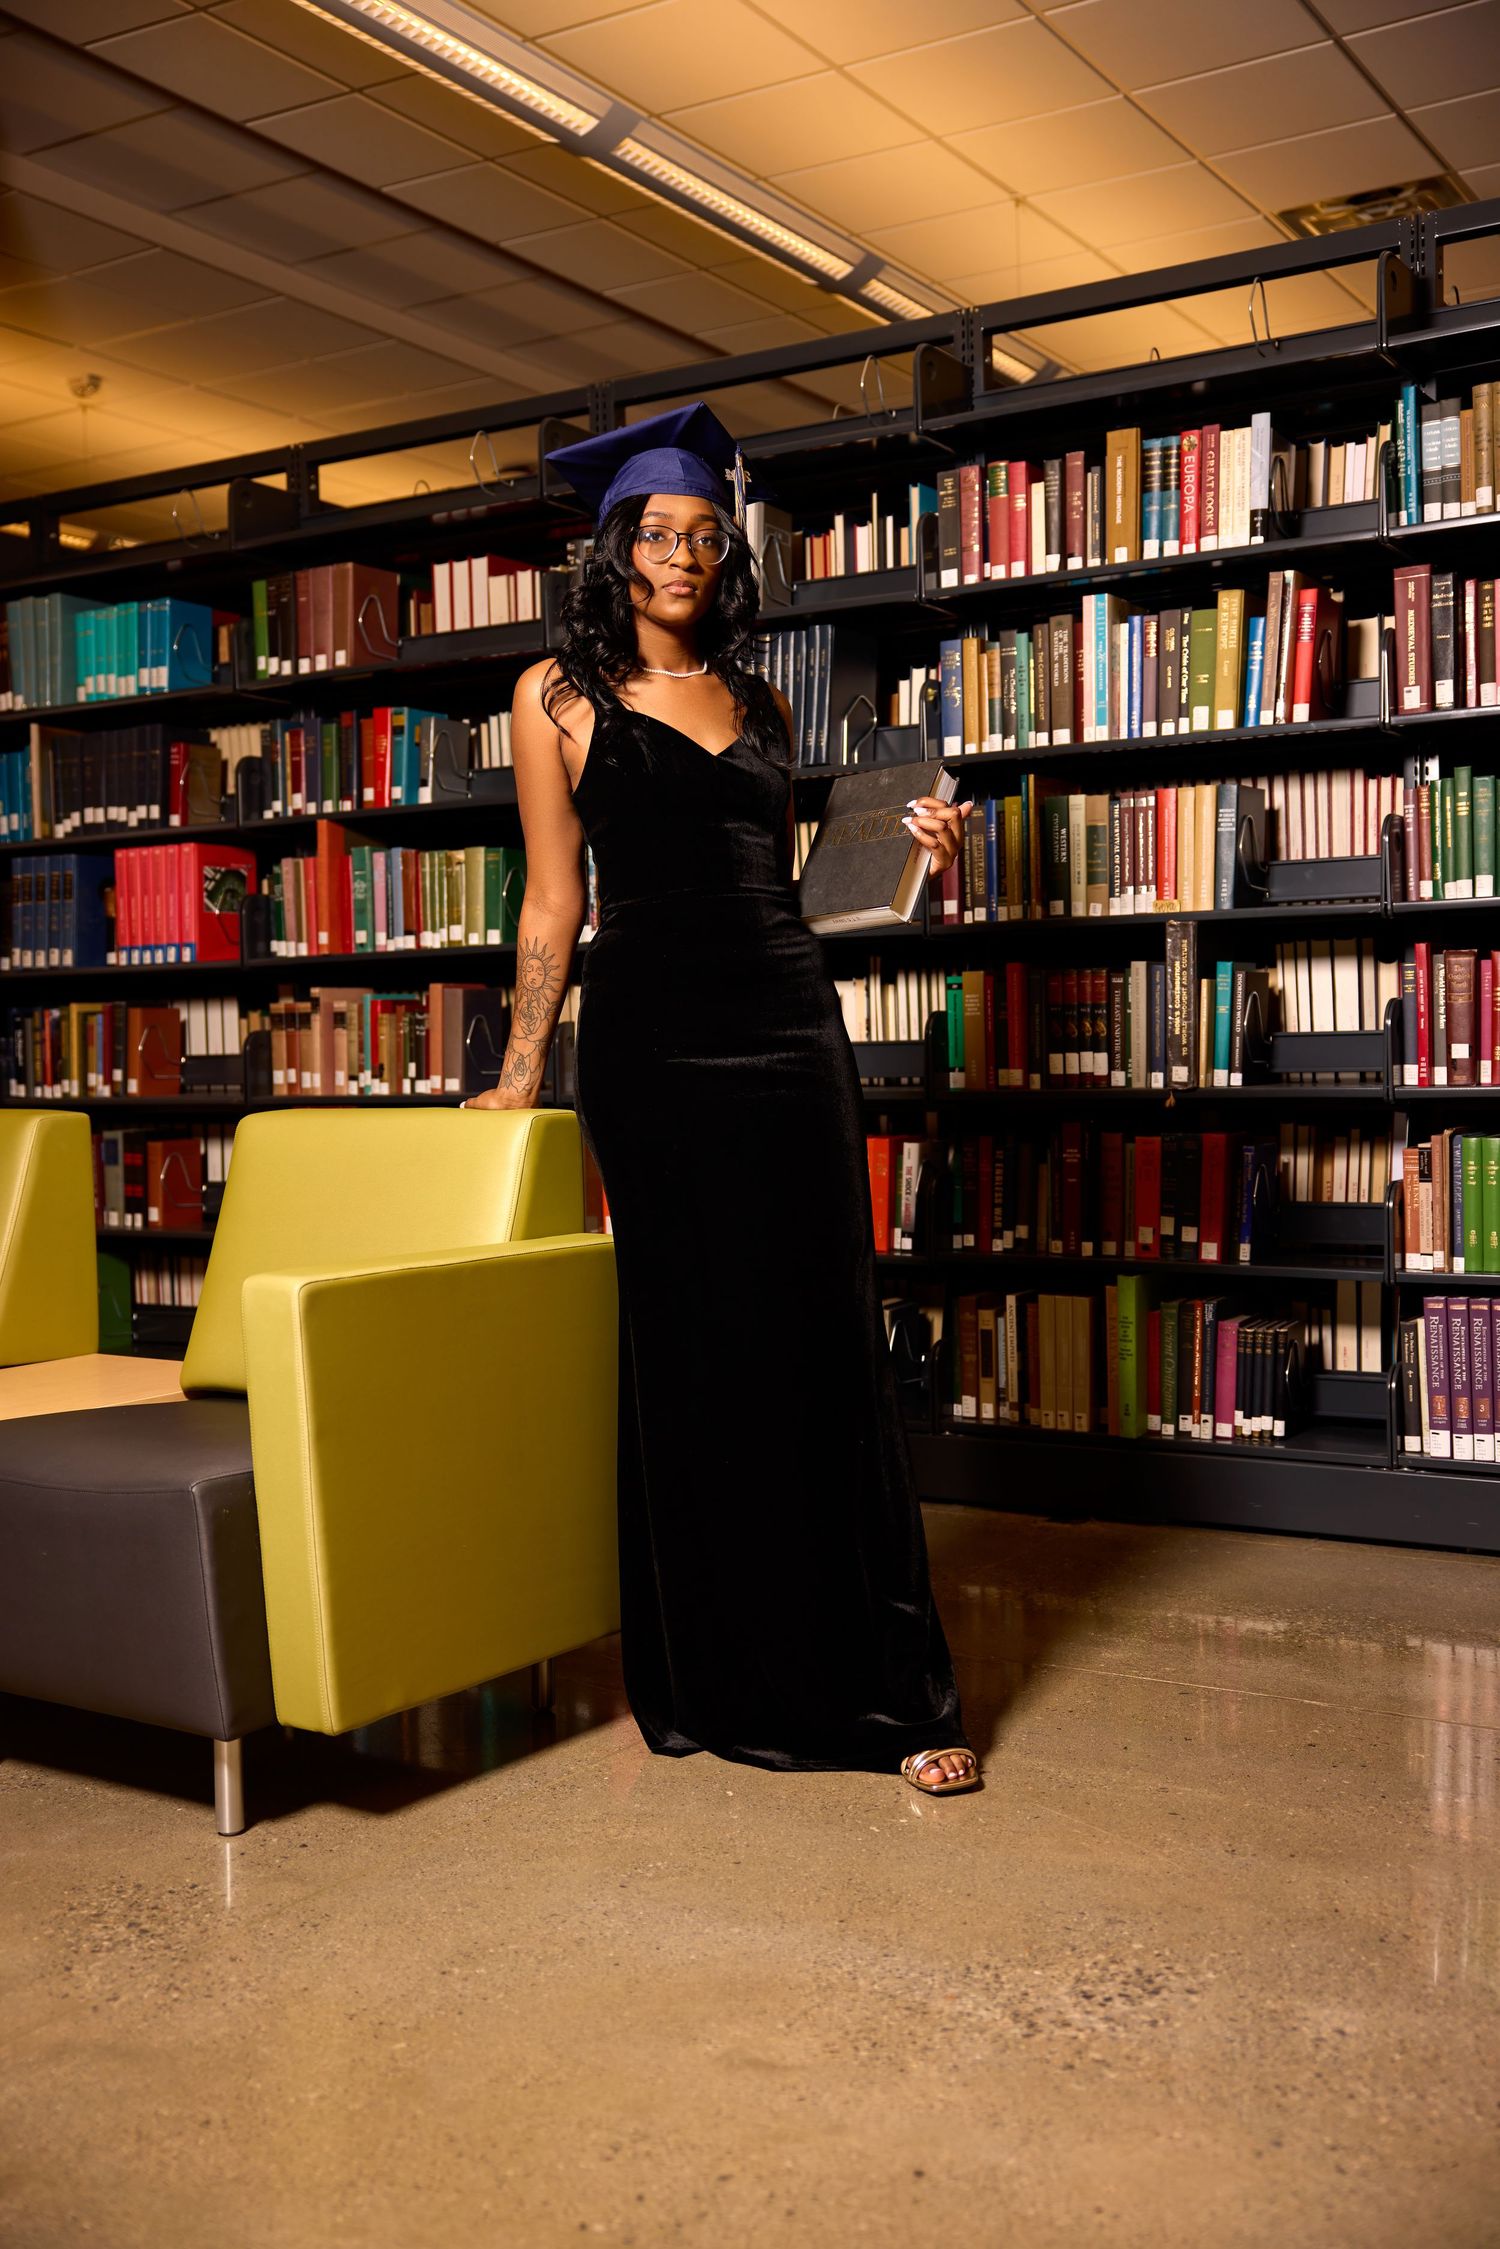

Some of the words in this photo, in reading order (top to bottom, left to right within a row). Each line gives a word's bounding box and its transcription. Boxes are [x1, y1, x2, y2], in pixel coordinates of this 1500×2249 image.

[1184, 455, 1195, 514] EUROPA
[1206, 450, 1215, 489] GREAT
[1205, 491, 1215, 527] BOOKS
[1221, 597, 1229, 610] OF
[1231, 597, 1239, 616] THE
[1058, 630, 1063, 639] OF
[1220, 612, 1229, 650] EUROPE
[1229, 618, 1238, 648] BIRTH
[1408, 652, 1416, 685] STUDIES
[1052, 813, 1060, 863] CIVILIZATION
[1114, 854, 1120, 864] OF
[1438, 1006, 1446, 1014] by
[1182, 1047, 1187, 1056] TO
[1454, 1170, 1462, 1204] TRACKS
[1165, 1317, 1175, 1355] Ancient
[1430, 1316, 1440, 1388] RENAISSANCE
[1452, 1318, 1462, 1390] RENAISSANCE
[1473, 1318, 1483, 1390] RENAISSANCE
[1164, 1358, 1176, 1419] Civilization
